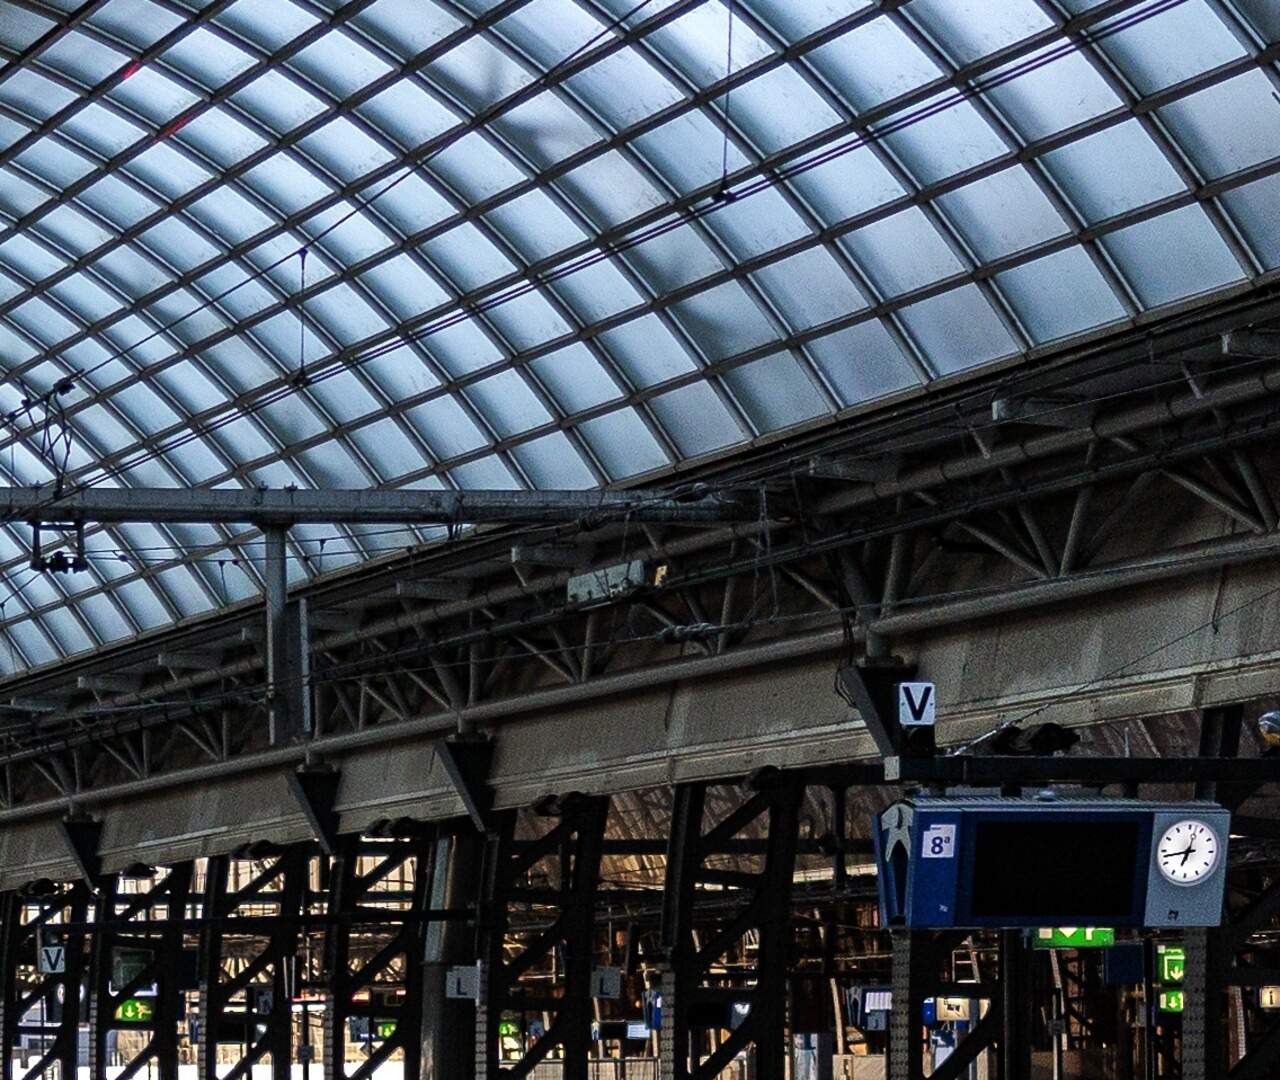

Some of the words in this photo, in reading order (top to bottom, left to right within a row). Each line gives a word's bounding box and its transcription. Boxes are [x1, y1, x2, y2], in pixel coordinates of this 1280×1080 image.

[902, 686, 932, 721] V
[44, 949, 62, 971] V
[456, 977, 467, 996] L
[599, 977, 610, 996] L
